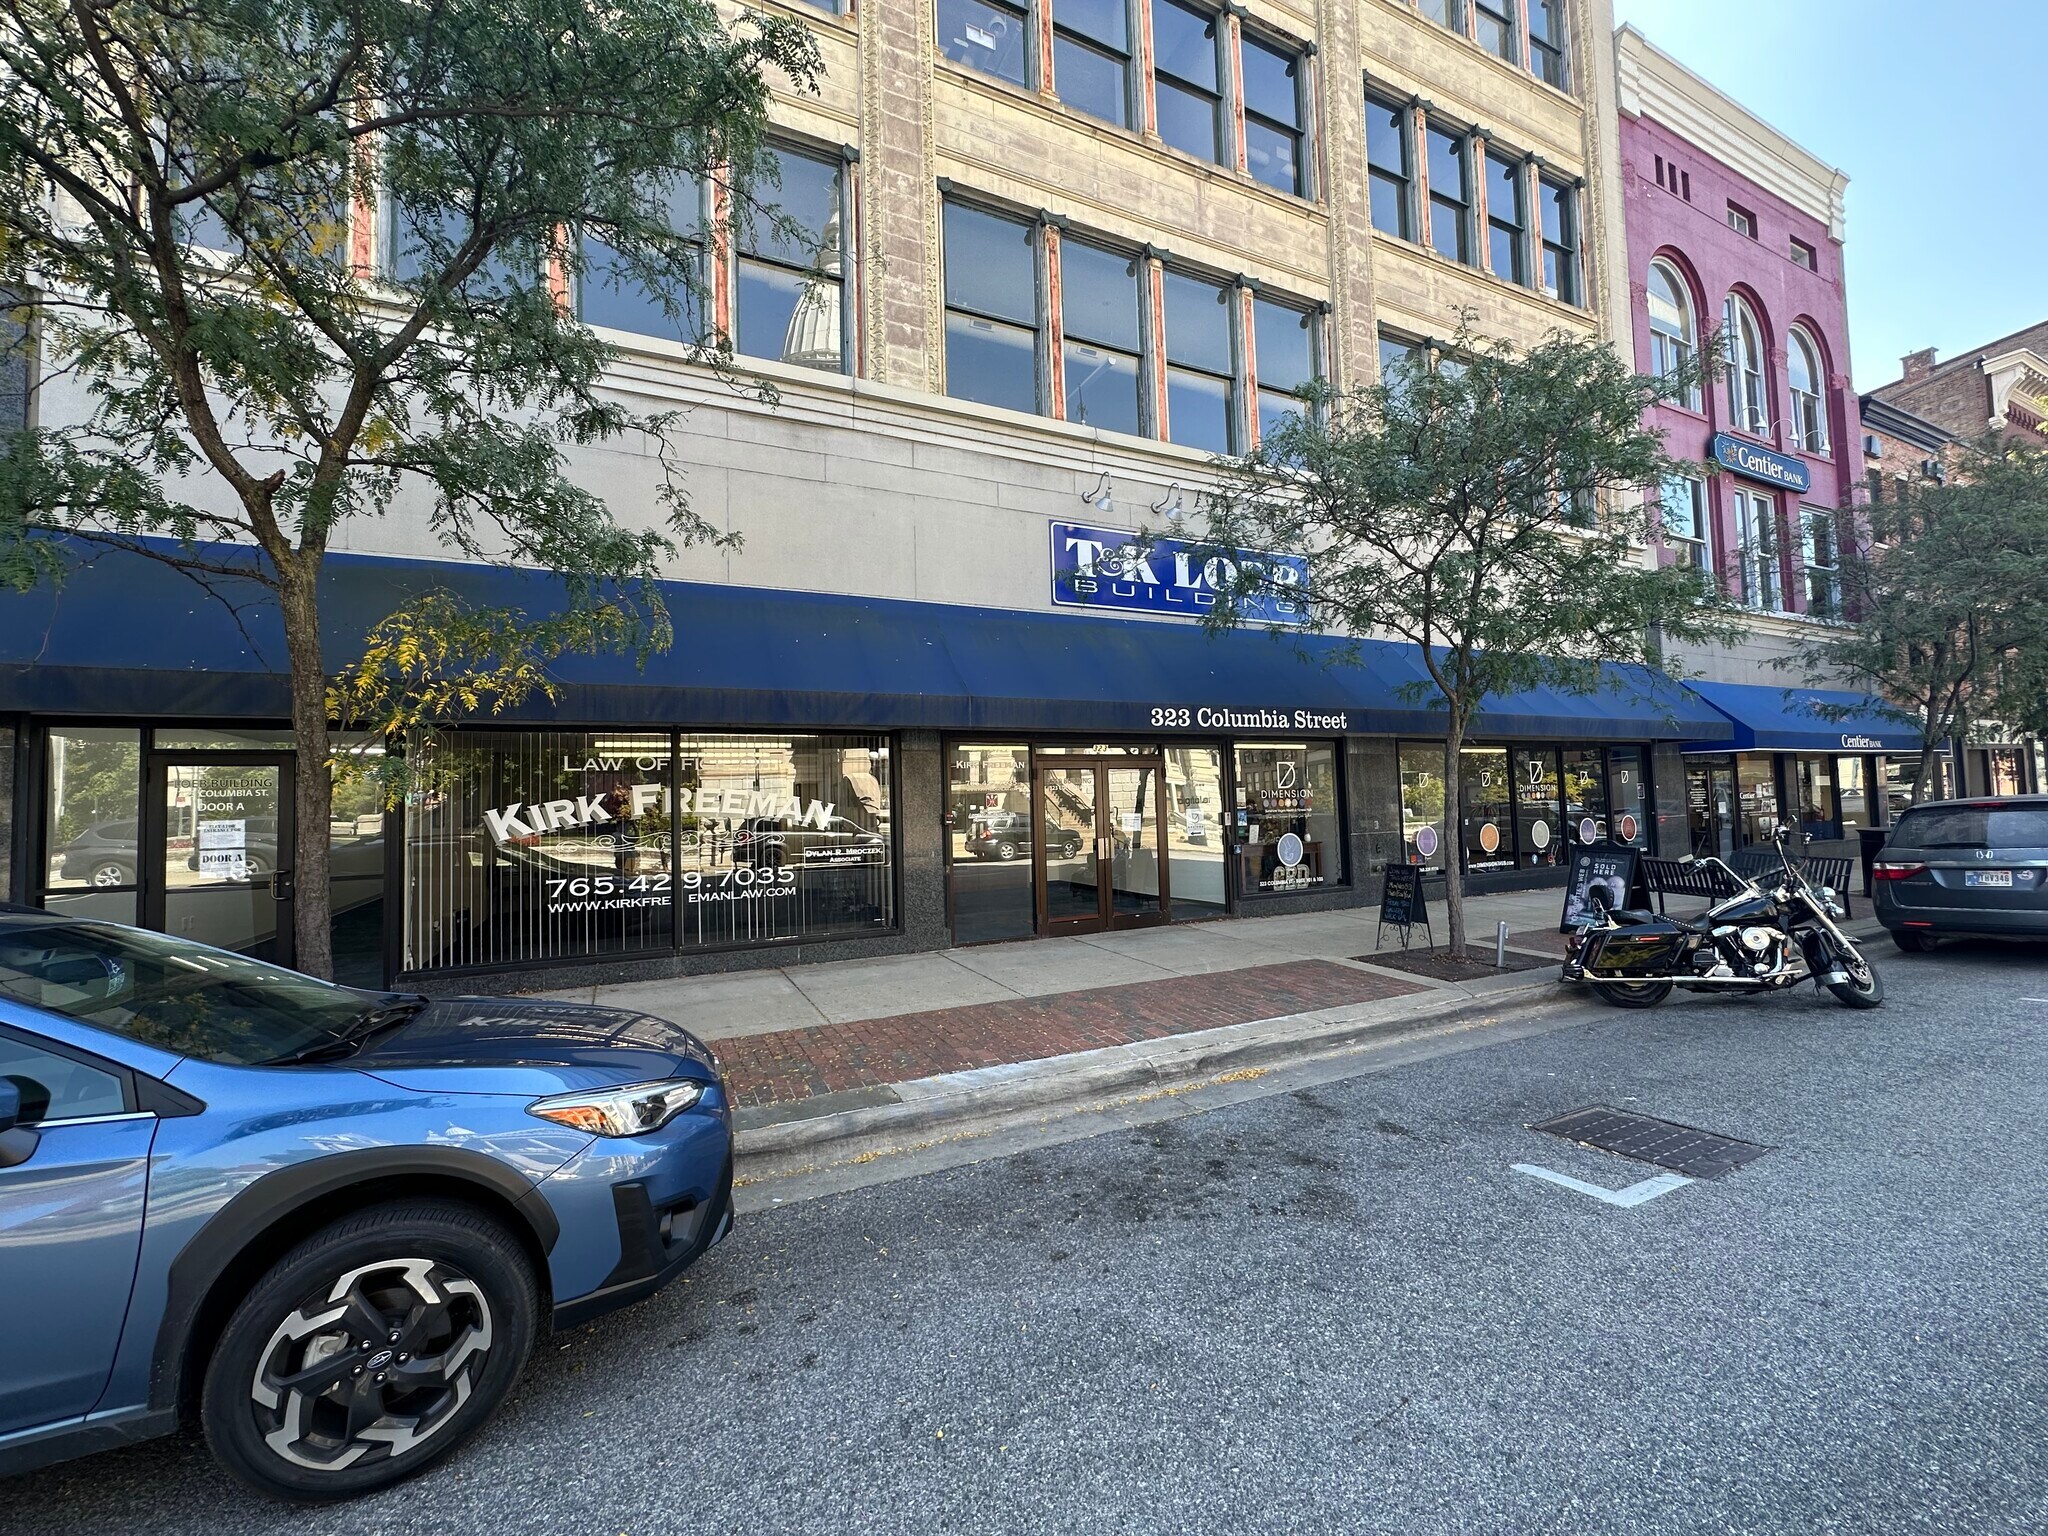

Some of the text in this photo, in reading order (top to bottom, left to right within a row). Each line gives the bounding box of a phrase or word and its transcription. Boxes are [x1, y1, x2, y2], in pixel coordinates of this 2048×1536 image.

[1738, 447, 1803, 485] Centier BANK
[1150, 707, 1347, 729] 323 Columbia Street
[1841, 734, 1882, 748] Centier BANK
[563, 755, 624, 771] LAW
[211, 779, 273, 788] BUILDING
[1519, 784, 1556, 792] DIMENSION
[198, 789, 269, 797] COLUMBIA ST.
[1261, 789, 1314, 799] DIMENSION
[198, 802, 245, 811] DOOR A
[482, 781, 836, 846] KIRK FREEMAN
[202, 855, 232, 863] DOOR
